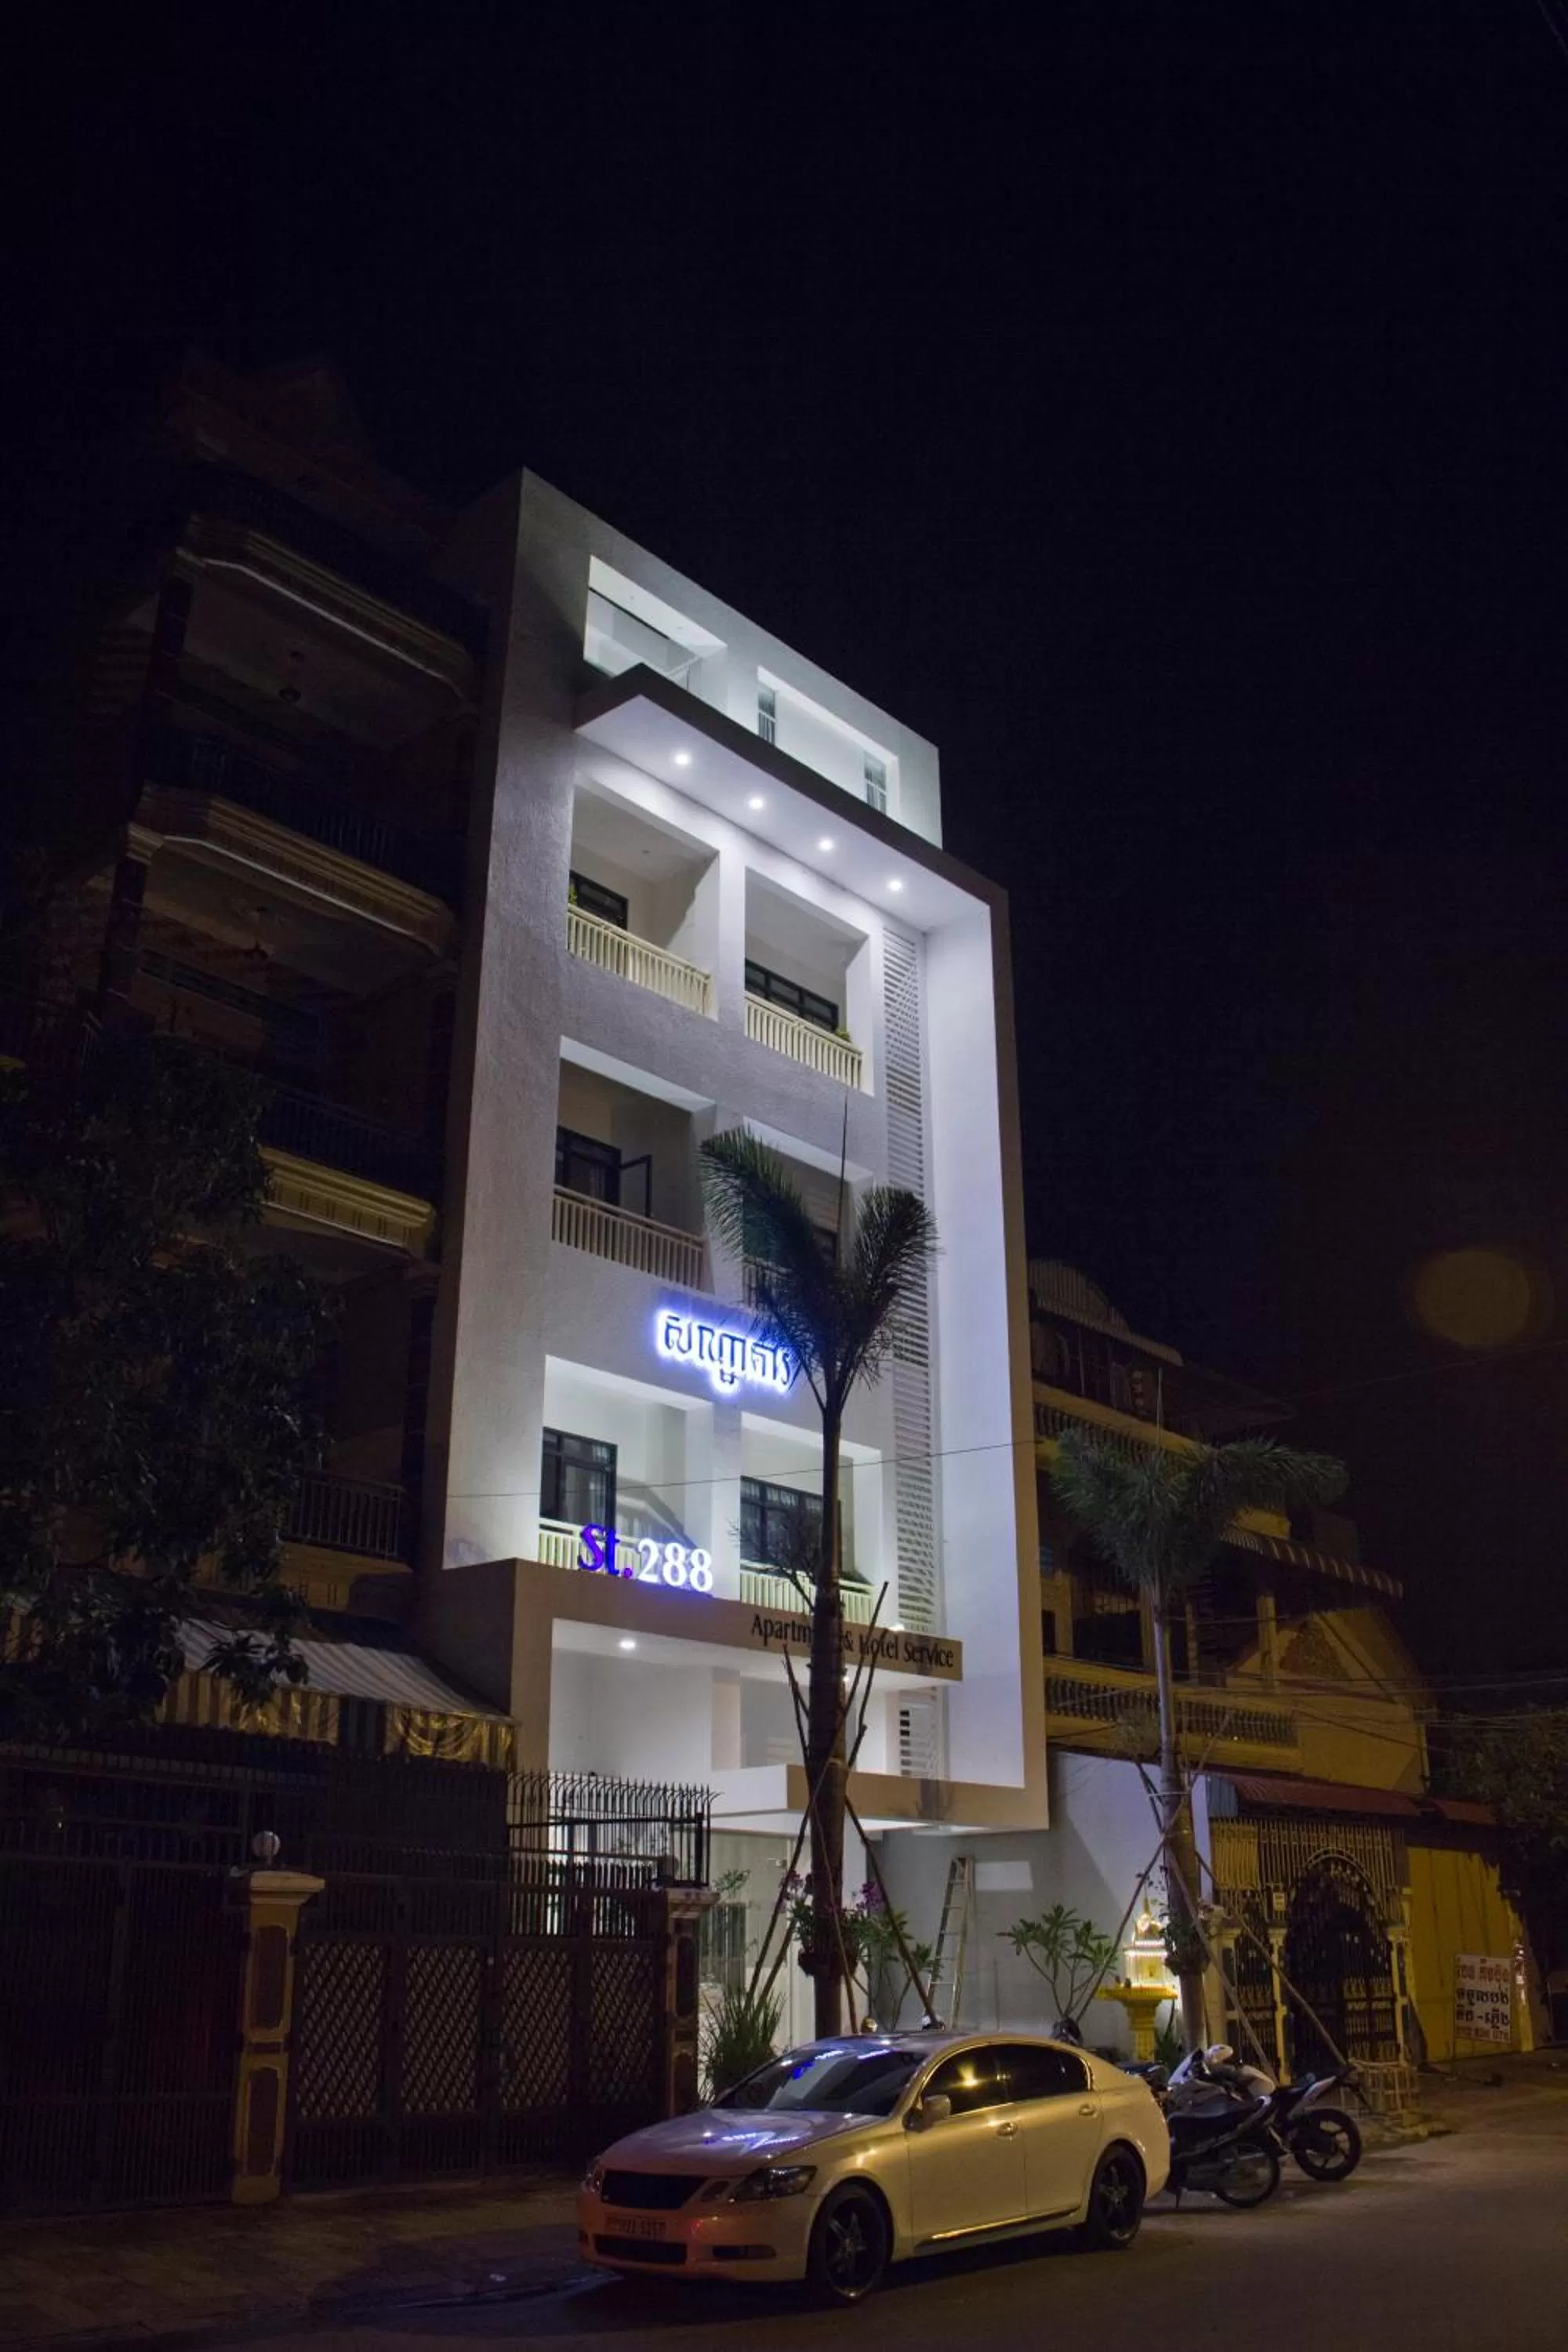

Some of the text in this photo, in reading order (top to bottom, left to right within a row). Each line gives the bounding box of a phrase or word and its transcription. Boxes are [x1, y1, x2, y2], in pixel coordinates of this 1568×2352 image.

[751, 1614, 954, 1668] Apartm & Hotel Service
